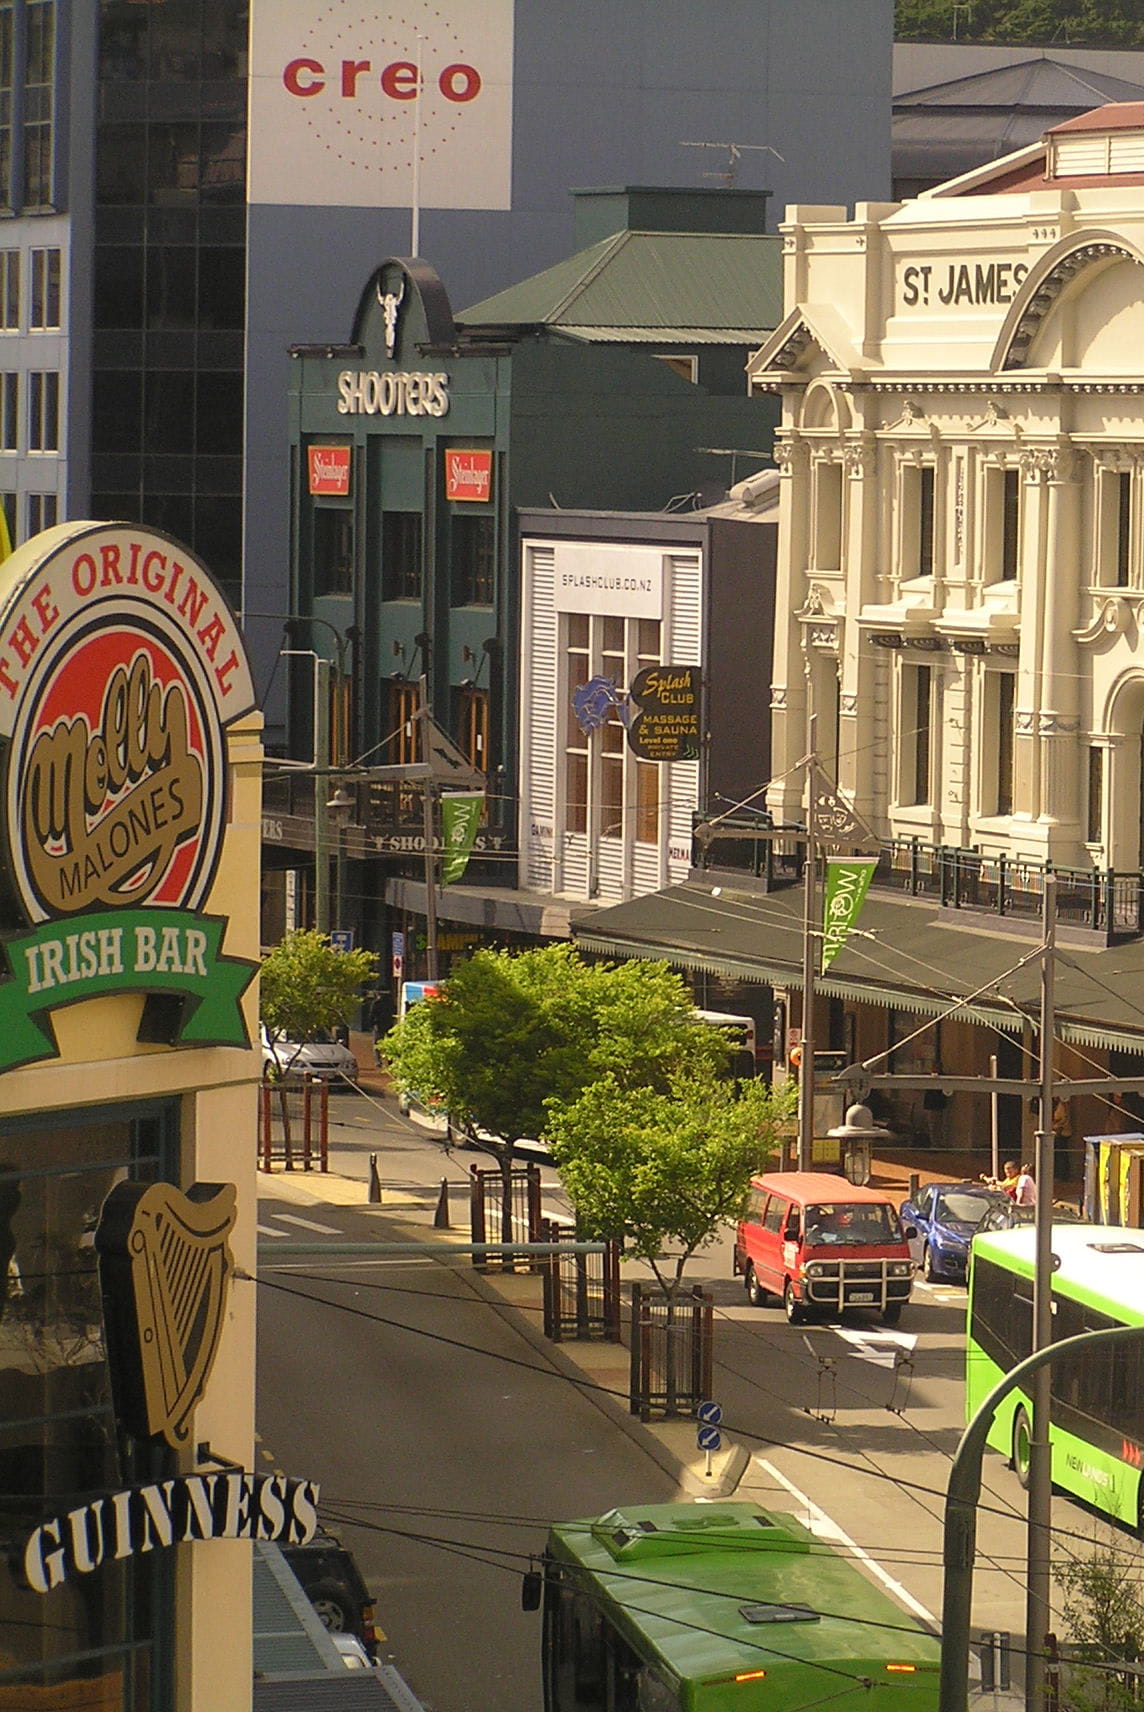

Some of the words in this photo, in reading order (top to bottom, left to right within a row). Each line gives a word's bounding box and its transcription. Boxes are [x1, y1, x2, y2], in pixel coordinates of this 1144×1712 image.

[283, 58, 481, 102] creo
[938, 263, 1029, 306] JAMES
[338, 370, 450, 417] SHOOTERS
[562, 574, 653, 592] SPLASHCLUB.CO.NZ
[0, 583, 60, 700] THE
[71, 543, 240, 697] ORIGINAL
[641, 670, 691, 698] Splash
[661, 692, 694, 704] CLUB
[639, 724, 649, 735] &
[654, 726, 698, 735] SAUNA
[643, 714, 698, 724] MASSAGE
[60, 777, 185, 900] MALONES
[25, 926, 125, 994] IRISH
[134, 926, 208, 977] BAR
[24, 1474, 321, 1594] GUINNESS
